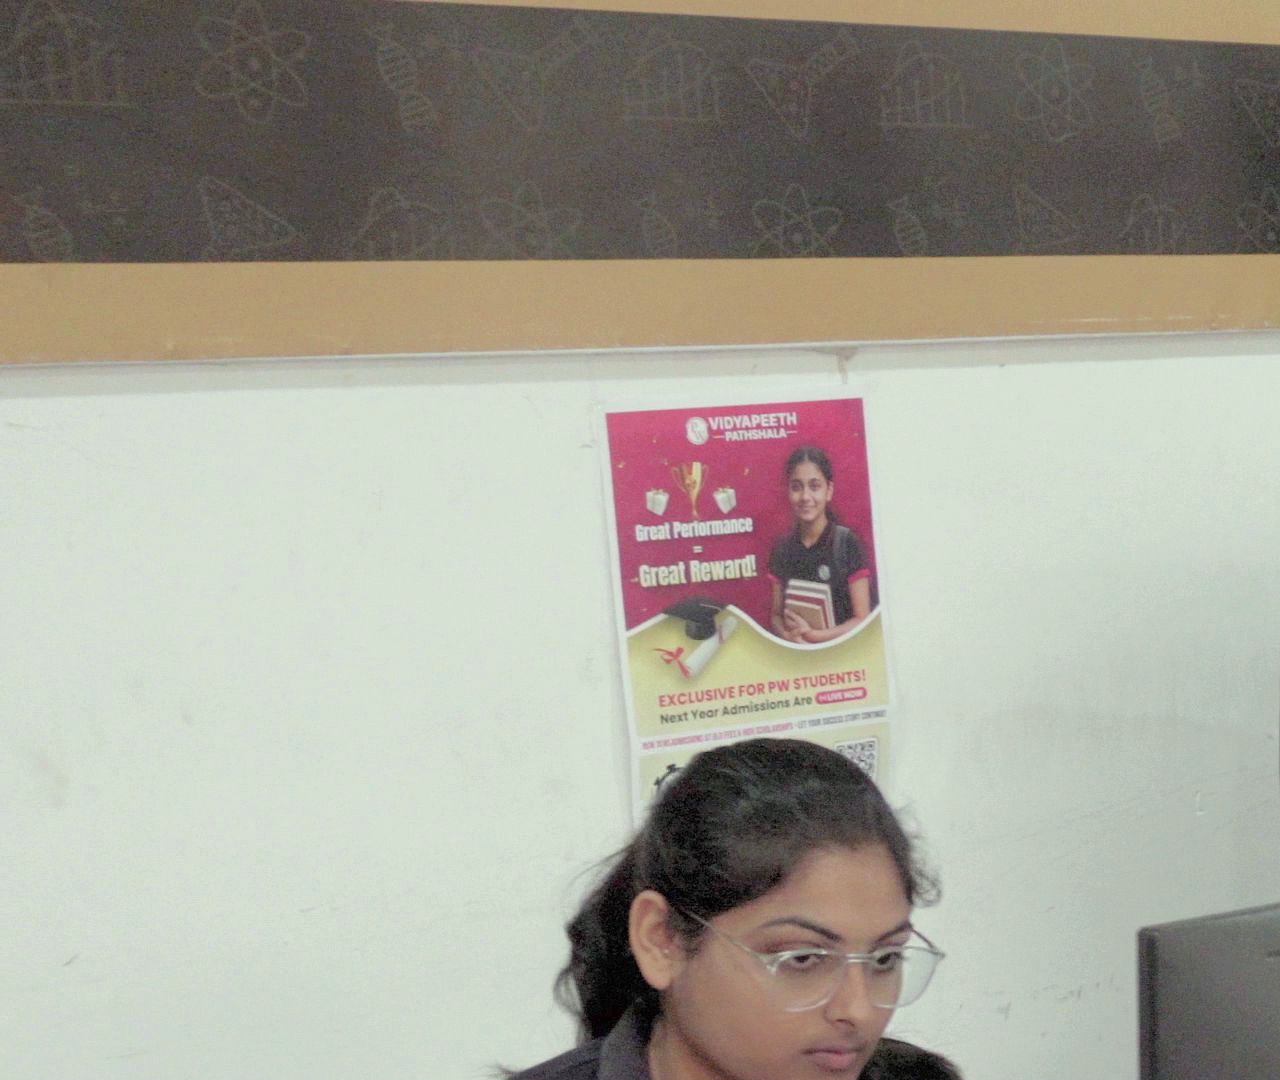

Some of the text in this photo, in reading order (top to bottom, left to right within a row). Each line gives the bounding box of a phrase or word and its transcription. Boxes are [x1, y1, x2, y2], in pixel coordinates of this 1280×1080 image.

[708, 412, 797, 431] VIDYAPEETH
[725, 428, 787, 442] PATHSHALA
[635, 517, 754, 542] Great Performance
[639, 554, 758, 588] Great Reward!
[659, 669, 866, 708] EXCLUSIVE FOR PW STUDENTS!
[660, 712, 688, 725] Next
[691, 708, 718, 720] Year
[722, 700, 790, 716] Admissions
[793, 696, 813, 706] Are
